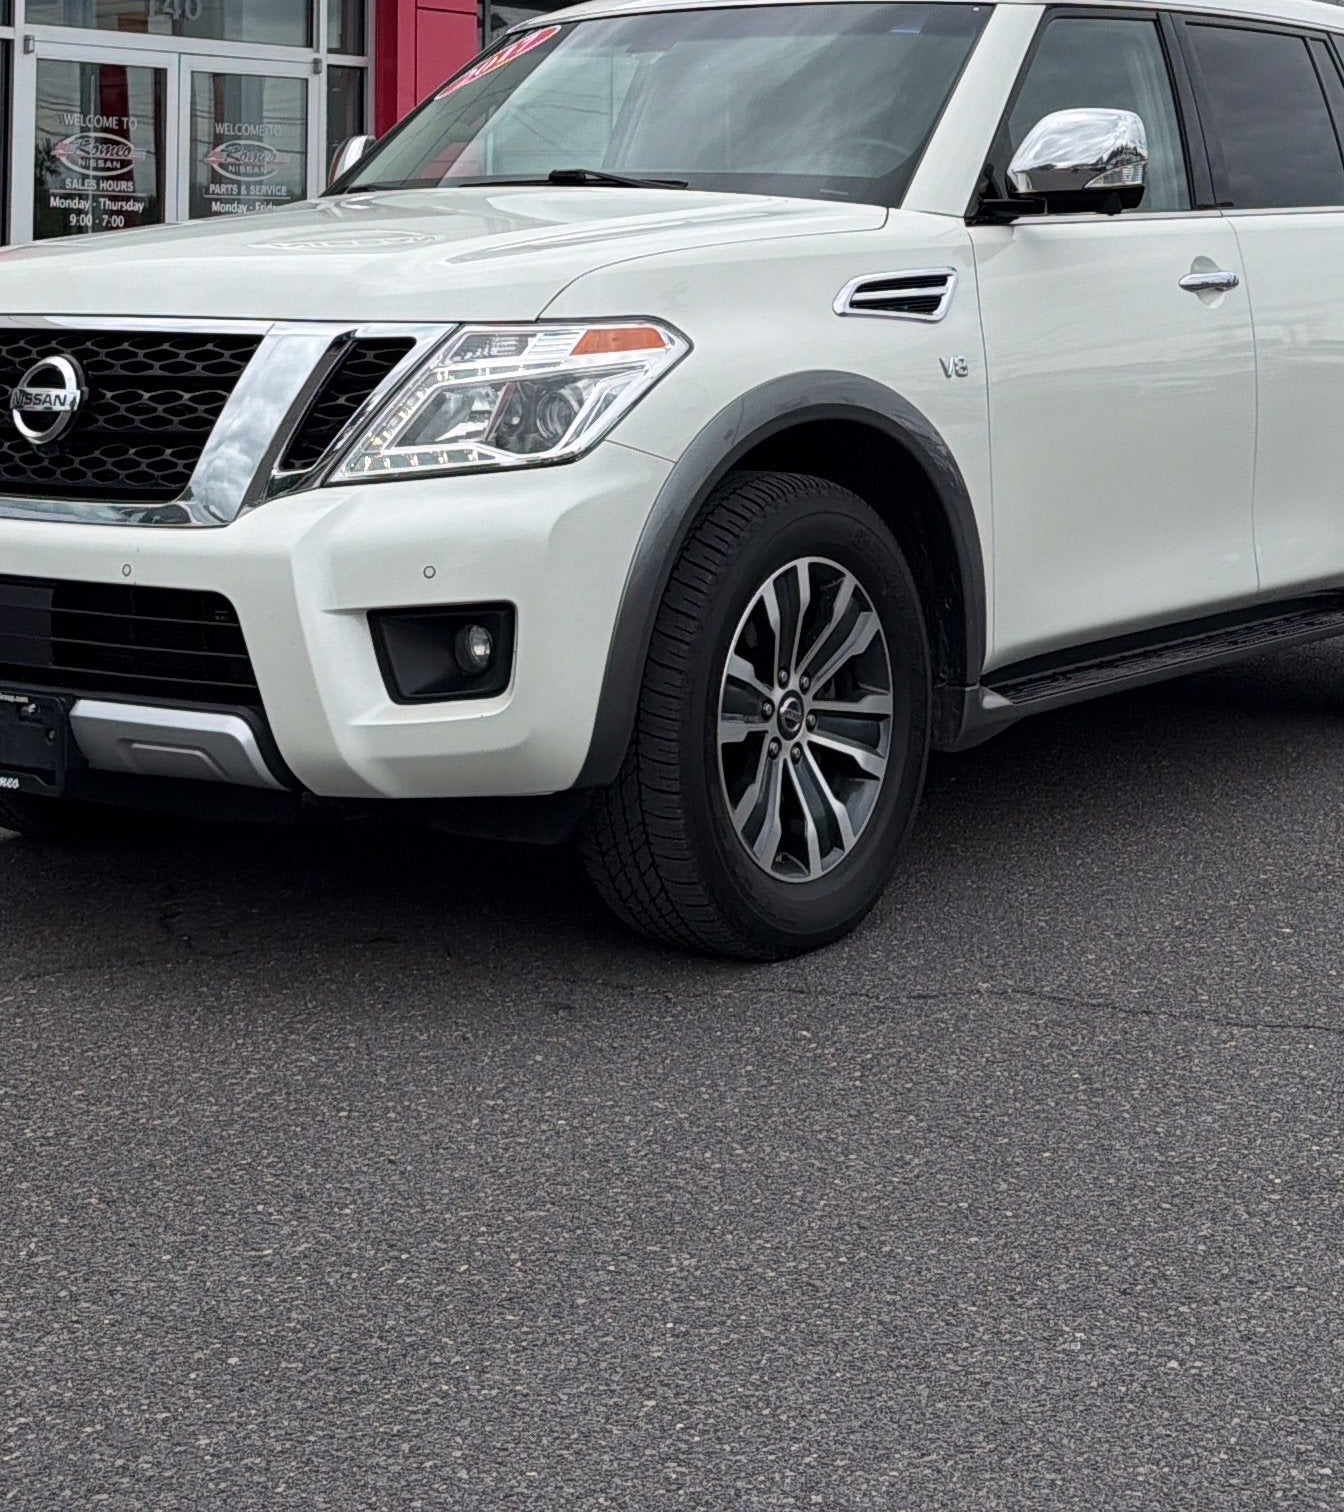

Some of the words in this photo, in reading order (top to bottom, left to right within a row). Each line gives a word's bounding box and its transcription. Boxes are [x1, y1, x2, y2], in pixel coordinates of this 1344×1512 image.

[64, 113, 119, 129] WELCOME
[121, 117, 137, 129] TO
[215, 122, 265, 136] WELCOME
[75, 137, 132, 157] Romeo
[78, 158, 121, 169] NISSAN
[228, 165, 267, 175] NISSAN
[65, 178, 97, 190] SALES
[99, 180, 134, 192] HOURS
[209, 183, 238, 195] PARTS
[240, 185, 248, 195] &
[249, 185, 287, 196] SERVICE
[49, 196, 91, 211] Monday
[99, 197, 145, 213] Thursday
[211, 201, 248, 214] Monday
[69, 213, 93, 226] 9:00
[102, 215, 125, 227] 7:00
[938, 355, 968, 378] V8
[16, 388, 67, 407] NISSAN
